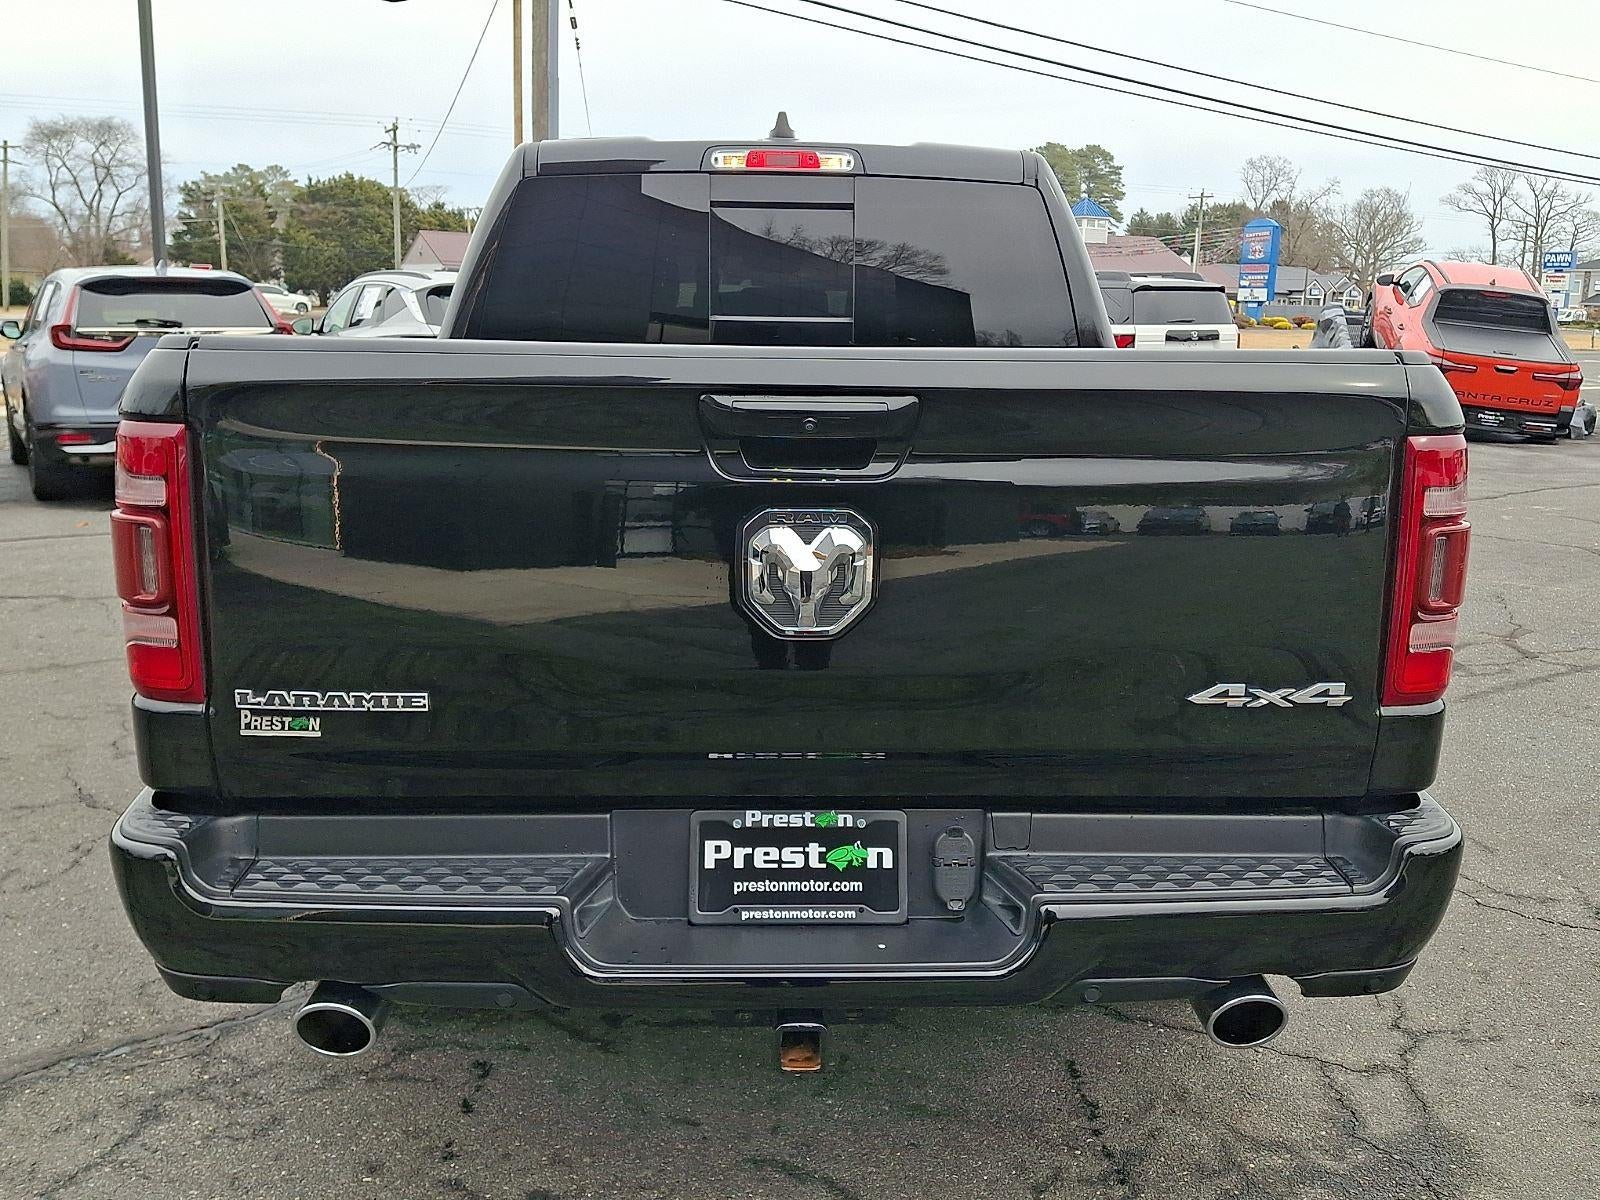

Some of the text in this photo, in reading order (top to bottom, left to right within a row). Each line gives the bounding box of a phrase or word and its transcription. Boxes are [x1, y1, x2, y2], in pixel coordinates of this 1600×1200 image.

[1544, 253, 1572, 263] PAWN
[1455, 390, 1554, 407] ANTA CRUZ
[1477, 413, 1505, 421] Prestn
[768, 512, 848, 523] RAM
[234, 689, 430, 712] LARAMIE
[1184, 682, 1354, 708] 4x4
[239, 709, 321, 732] PRESTN
[745, 810, 854, 828] Prestn
[703, 840, 894, 871] Prestn
[732, 879, 864, 895] prestonmotor.com
[740, 908, 857, 921] prestonmotor.com
